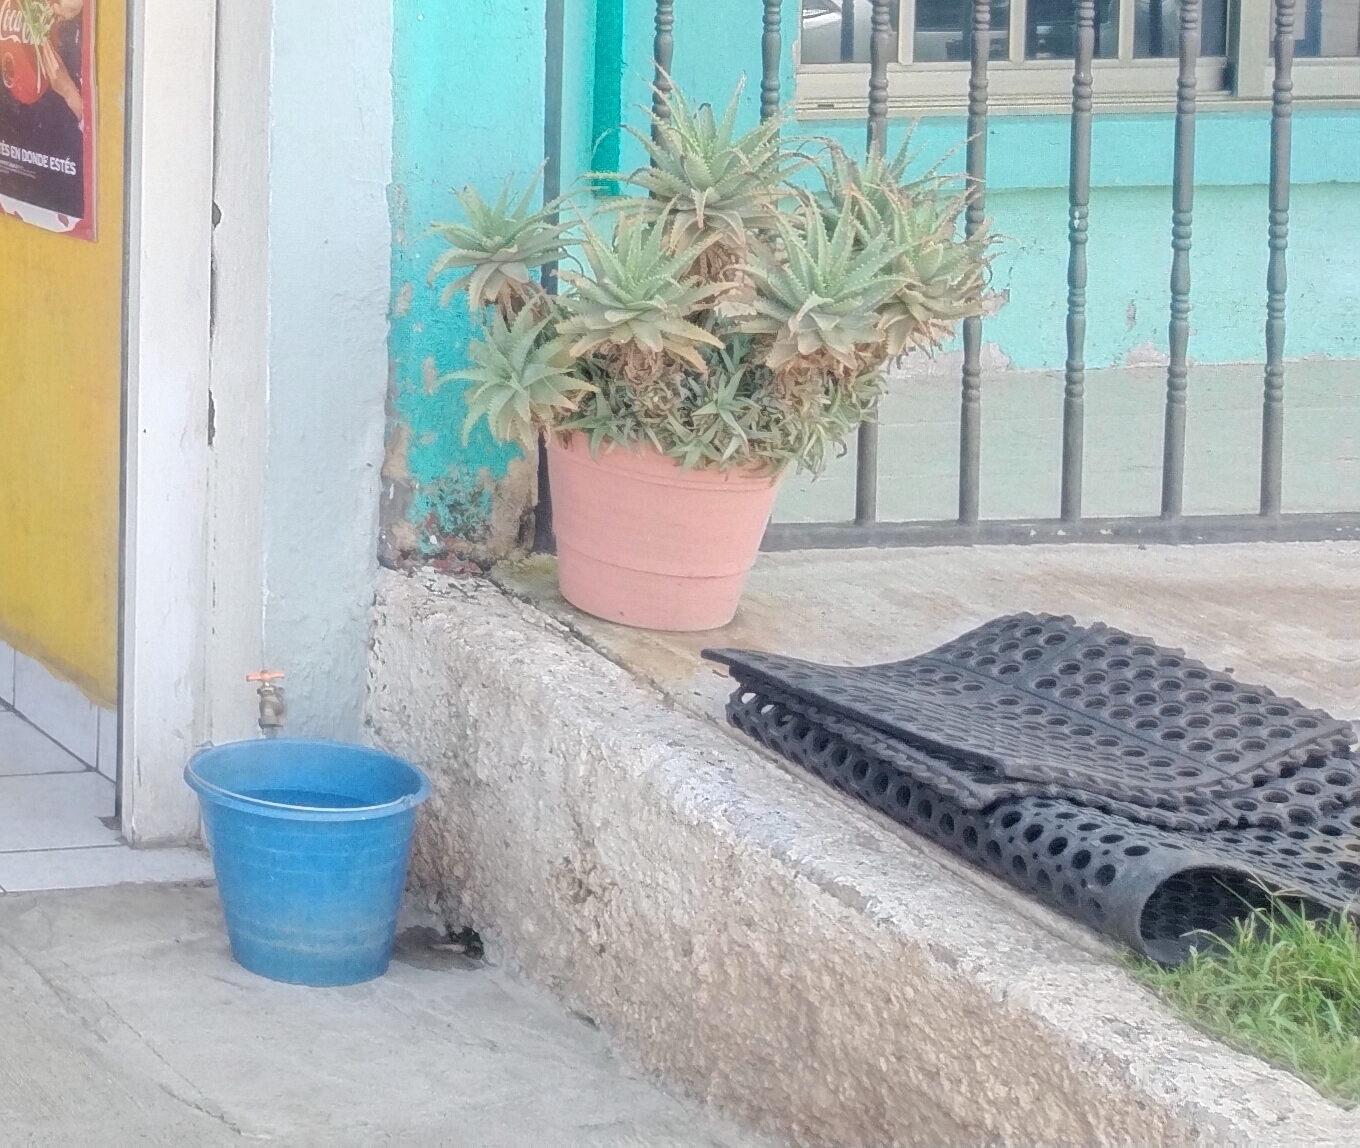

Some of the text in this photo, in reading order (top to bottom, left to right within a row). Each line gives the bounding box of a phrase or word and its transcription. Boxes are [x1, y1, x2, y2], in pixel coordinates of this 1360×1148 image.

[10, 145, 21, 161] EN
[21, 149, 48, 168] DONDE
[49, 156, 77, 175] ESTÉS
